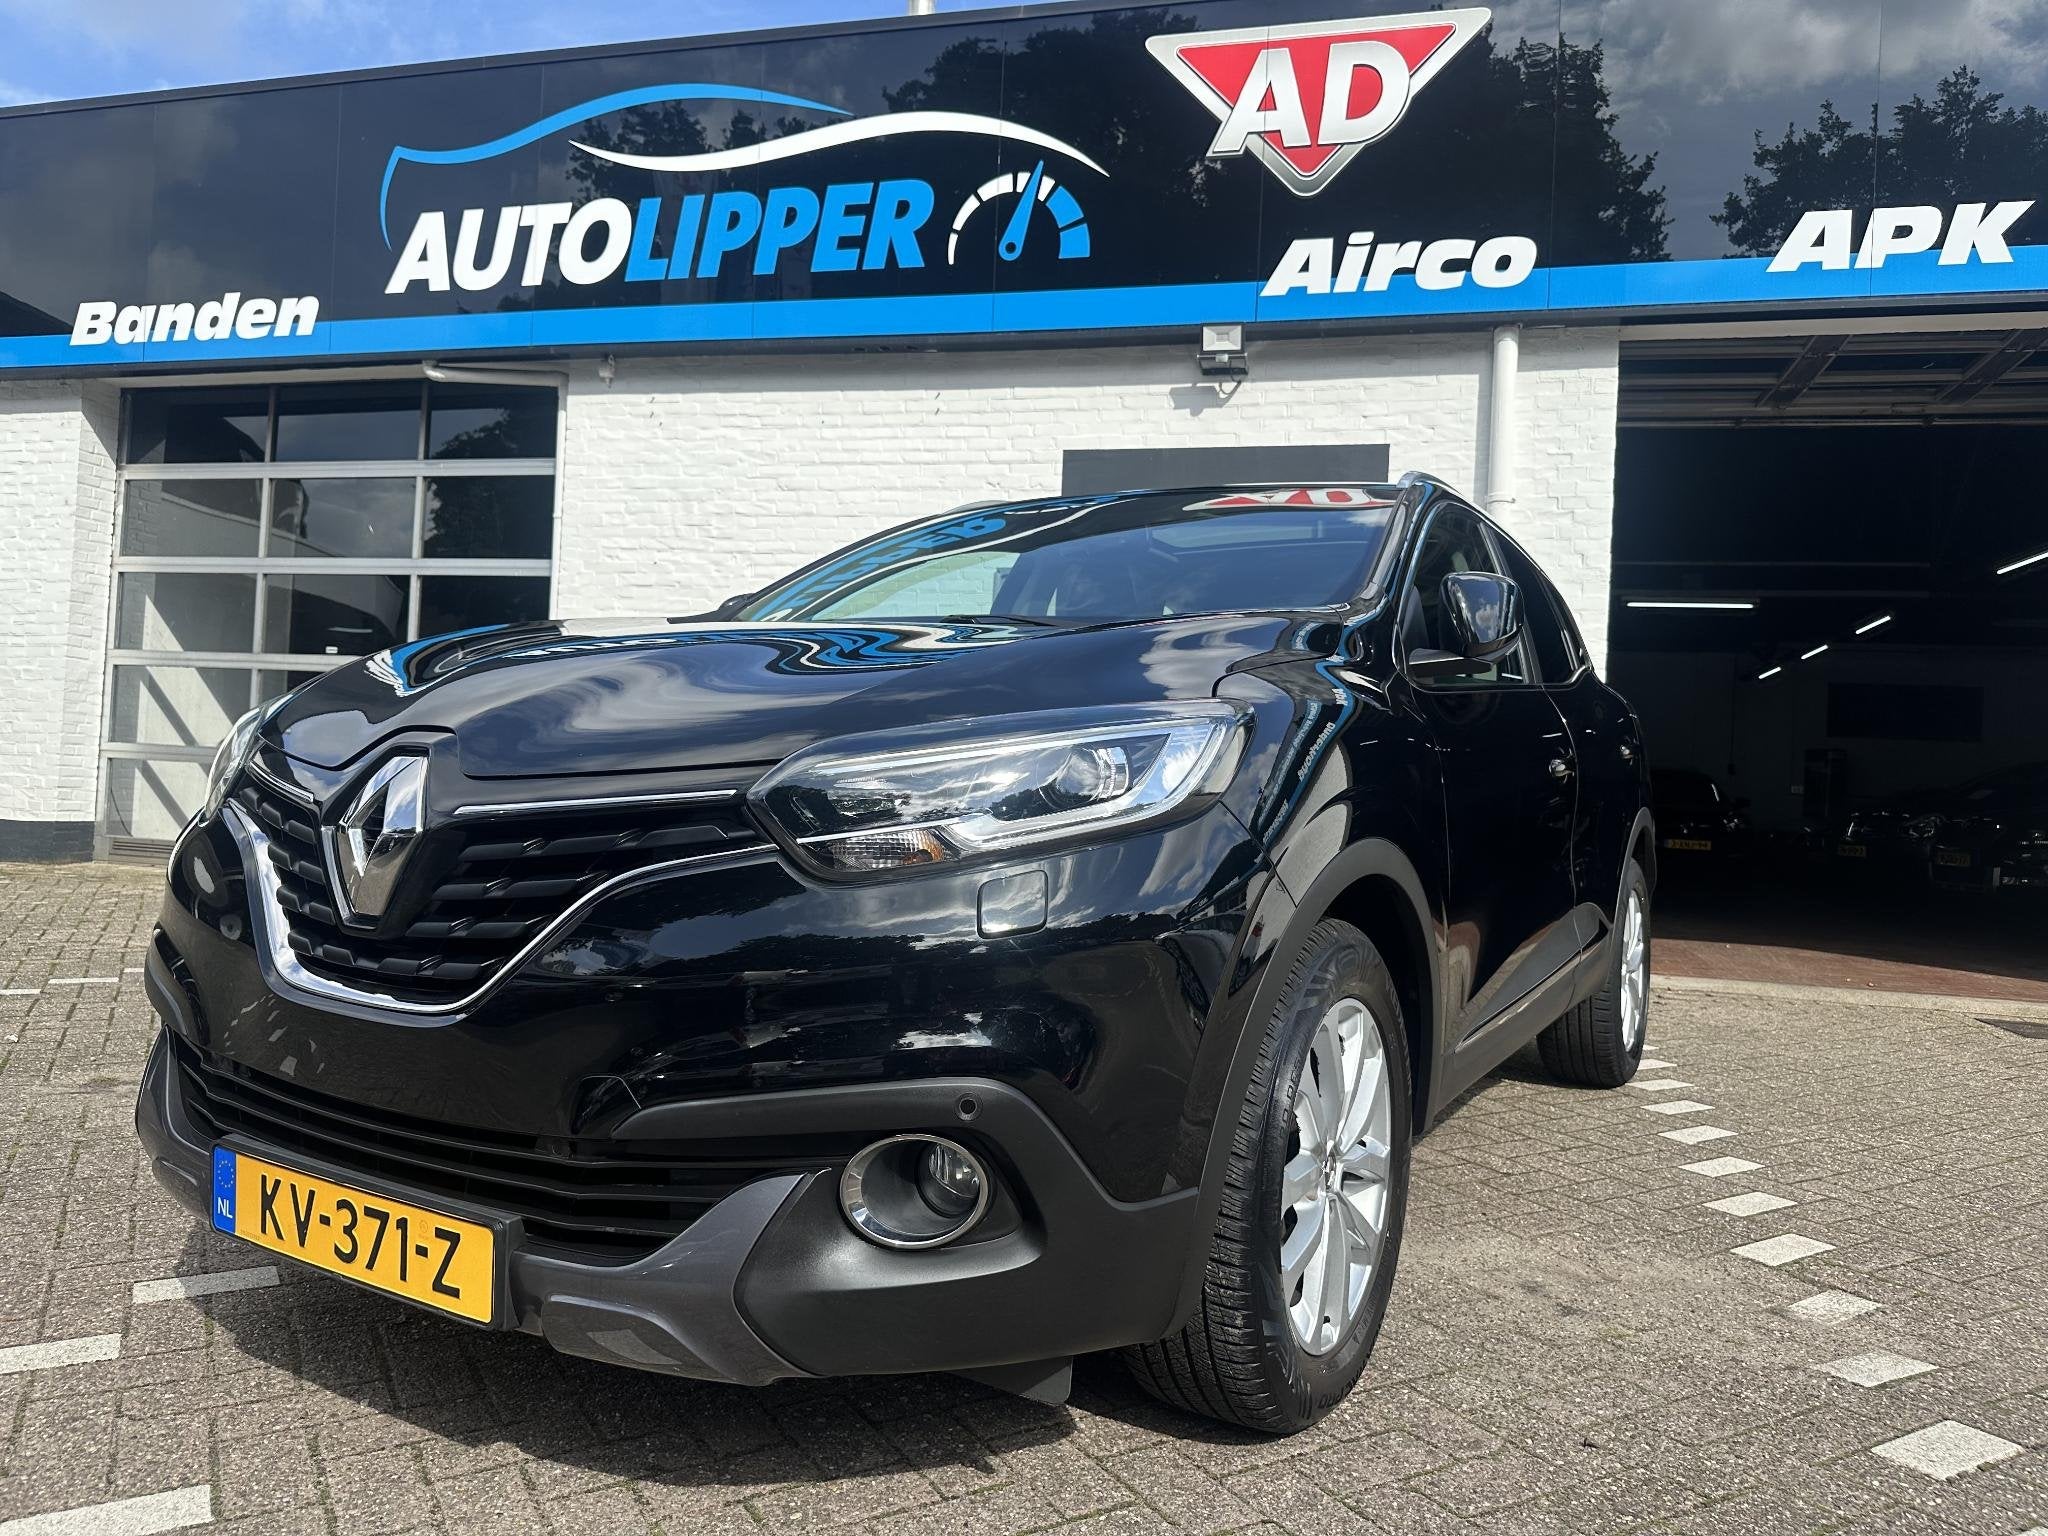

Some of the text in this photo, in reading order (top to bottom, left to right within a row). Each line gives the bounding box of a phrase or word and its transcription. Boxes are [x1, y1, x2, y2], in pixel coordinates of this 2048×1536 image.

[1212, 40, 1411, 153] AD
[1260, 232, 1537, 297] Airco
[1766, 200, 2036, 273] APK
[69, 291, 320, 346] Banden
[217, 1196, 233, 1219] NL
[260, 1174, 461, 1299] KV-371-Z
